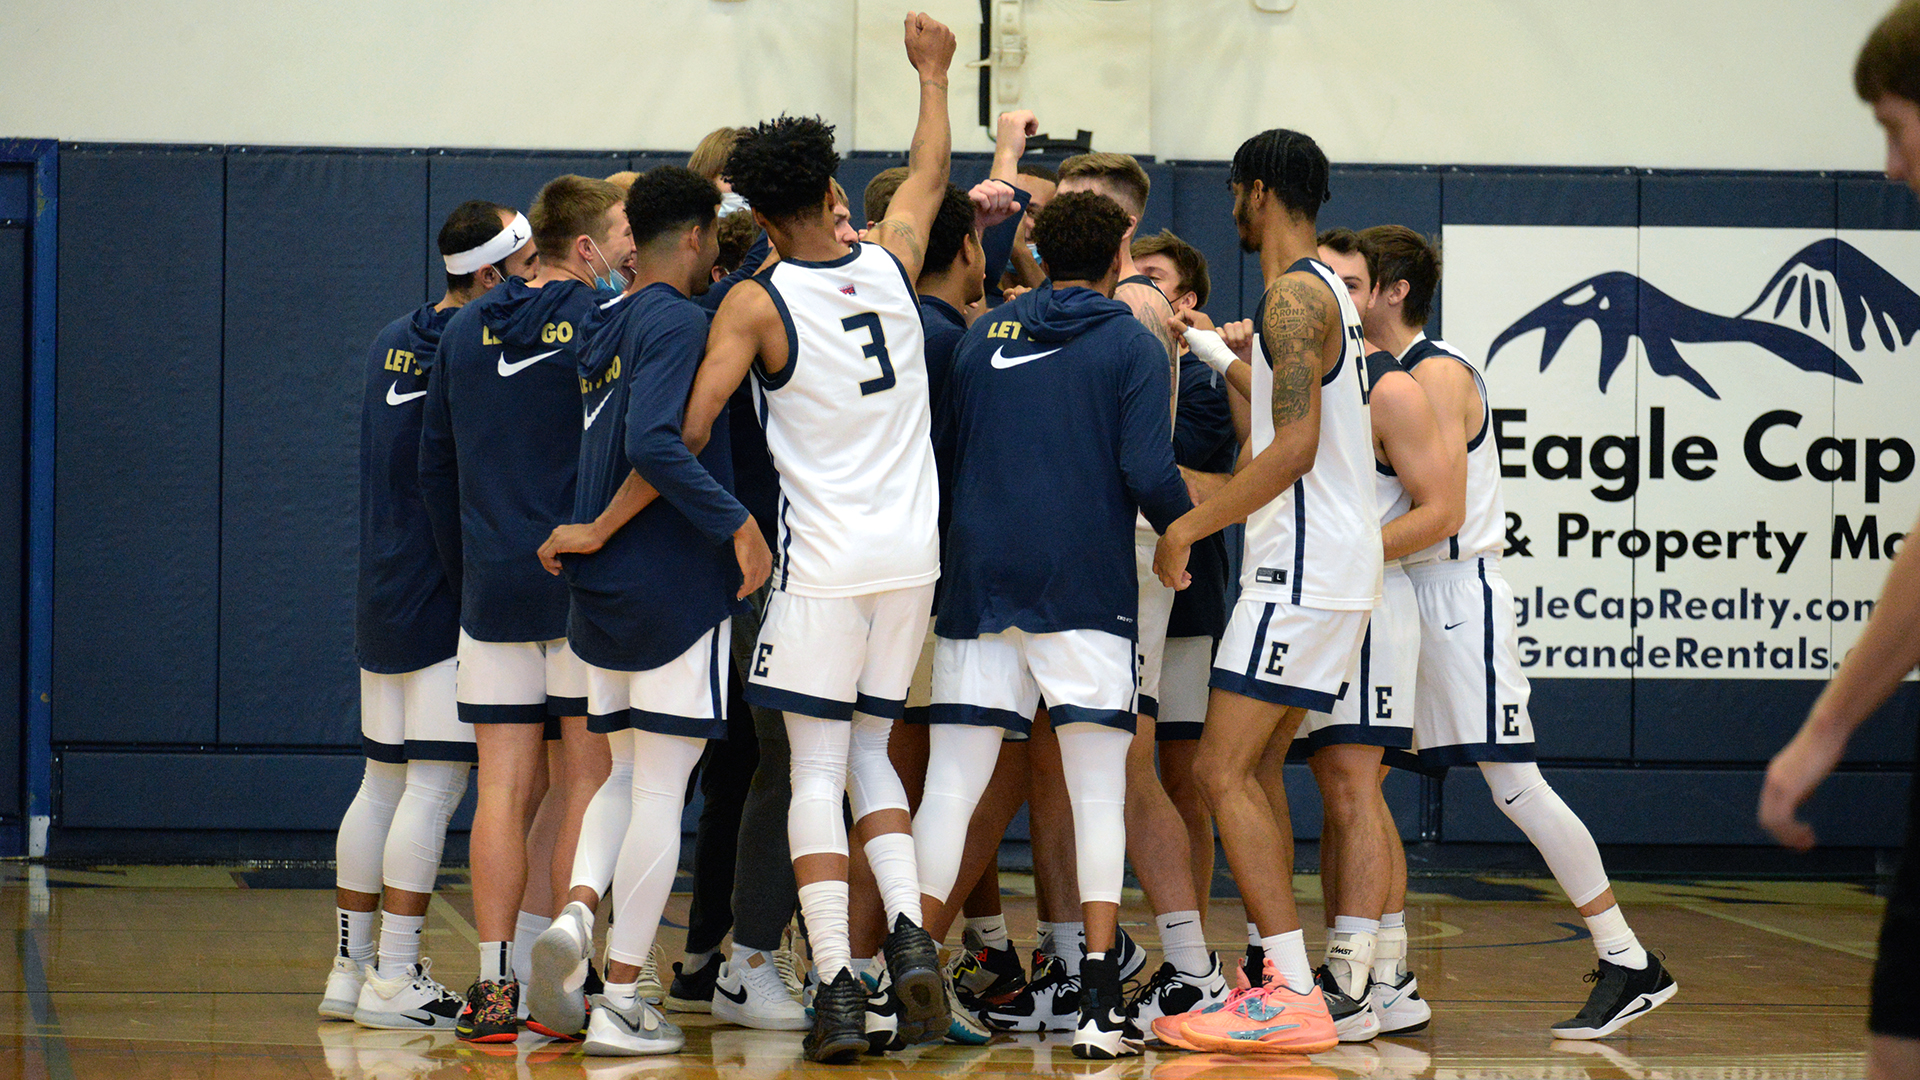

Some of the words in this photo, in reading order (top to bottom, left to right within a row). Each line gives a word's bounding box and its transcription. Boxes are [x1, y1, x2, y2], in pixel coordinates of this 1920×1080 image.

[541, 321, 574, 344] GO
[1268, 306, 1306, 329] BRONX
[840, 311, 897, 397] 3
[1491, 407, 1719, 502] Eagle
[1743, 409, 1916, 504] Cap
[1502, 511, 1534, 558] &
[1557, 512, 1808, 574] Property
[754, 642, 774, 678] E
[1265, 641, 1290, 677] E
[1517, 635, 1854, 670] GrandeRentals.
[1375, 686, 1393, 719] E
[1502, 704, 1520, 737] E
